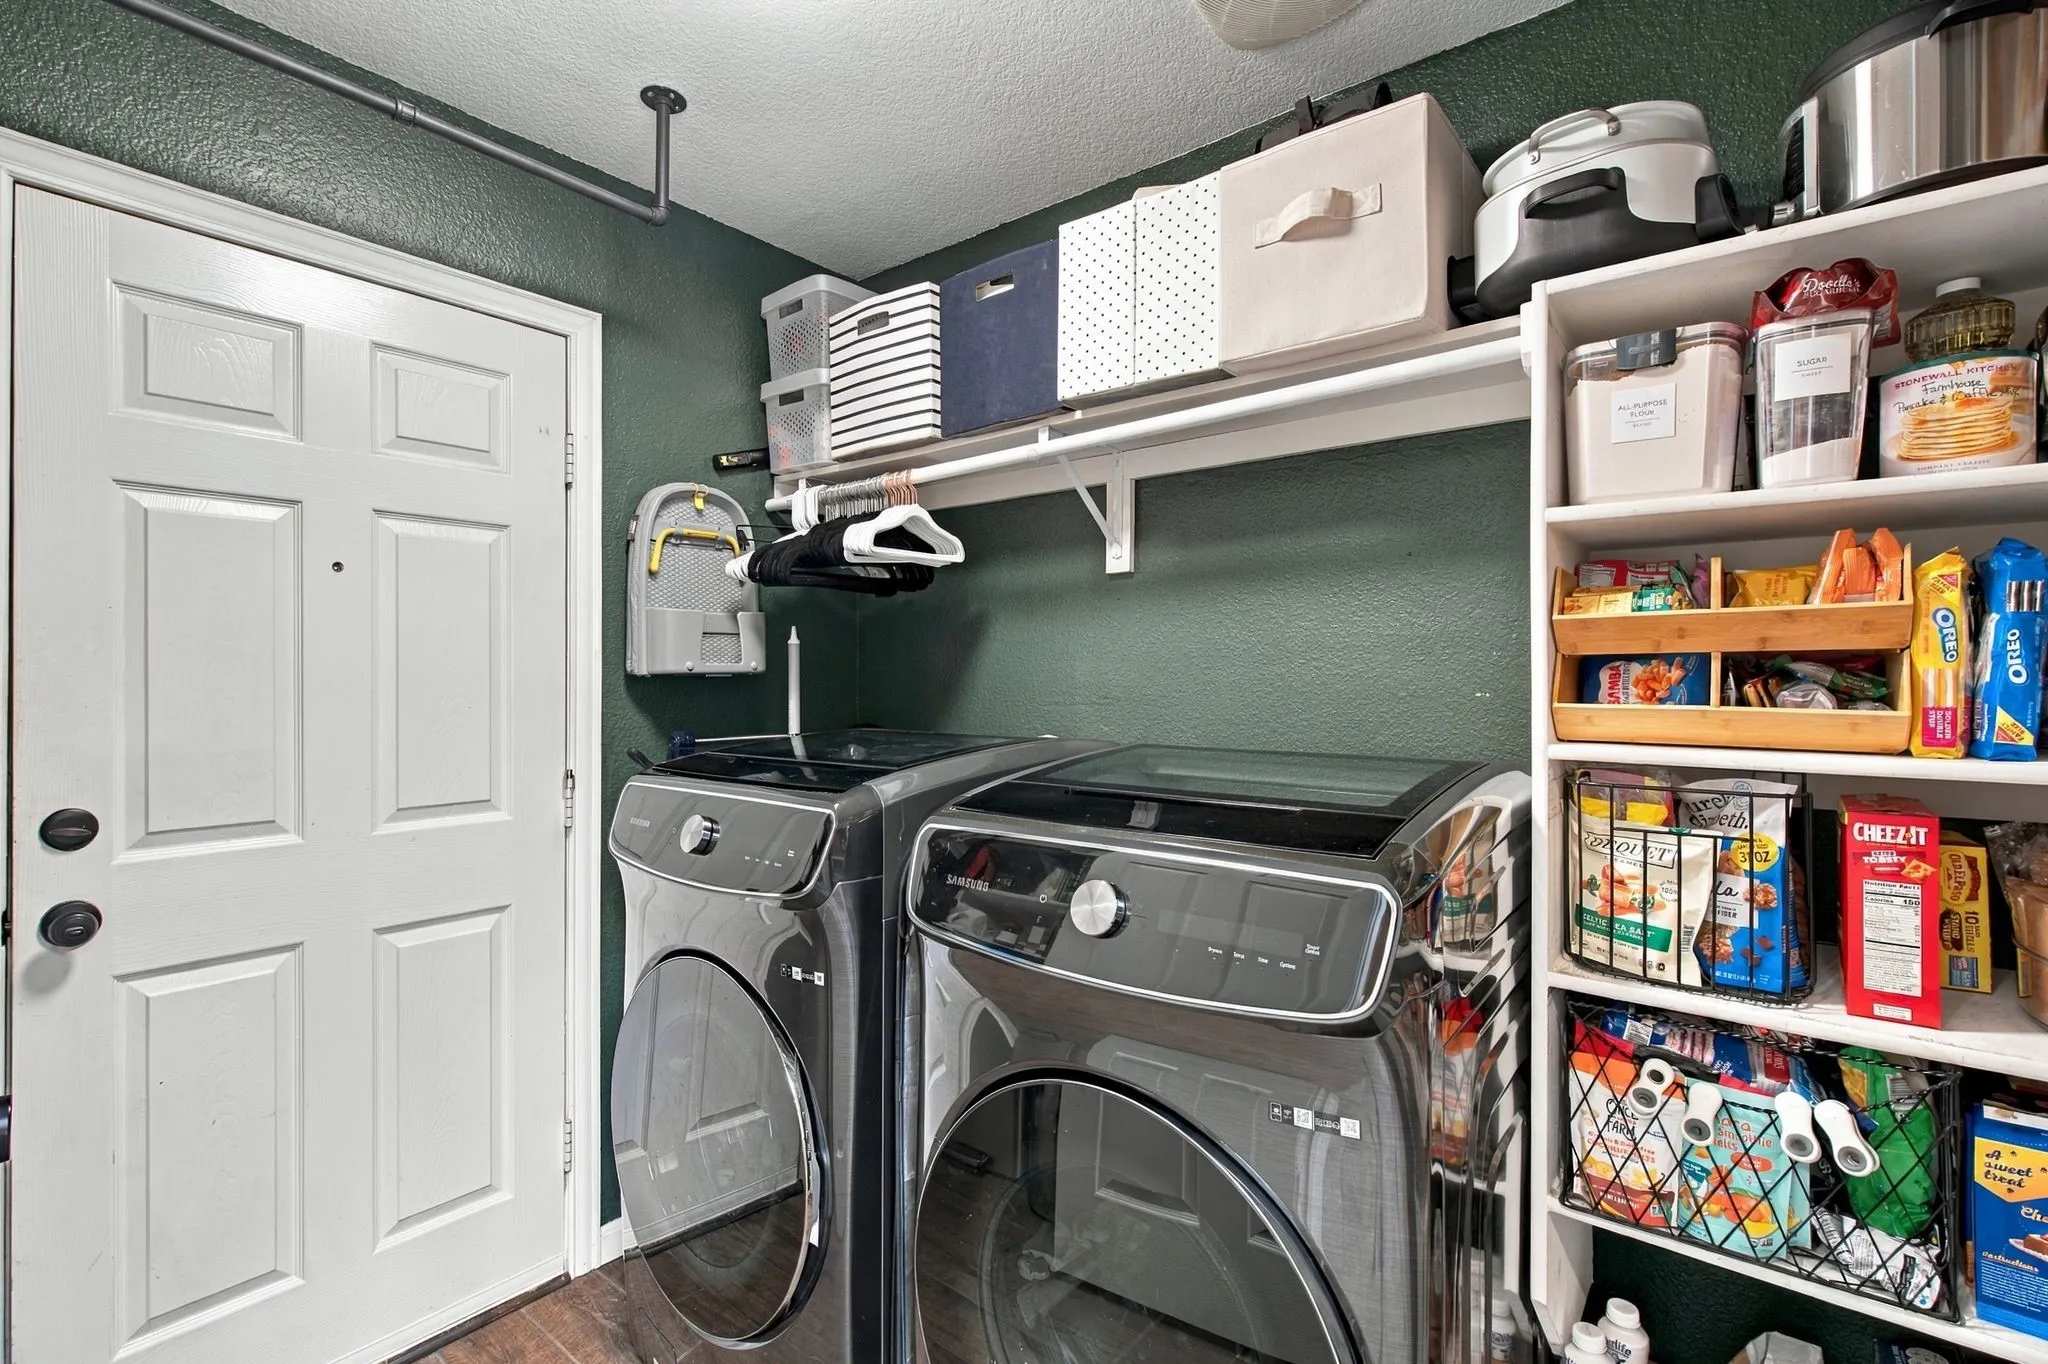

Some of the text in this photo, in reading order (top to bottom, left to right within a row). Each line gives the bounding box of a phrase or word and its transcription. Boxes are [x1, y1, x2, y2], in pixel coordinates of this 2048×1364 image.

[1797, 356, 1828, 367] SUGAR
[1894, 371, 1962, 389] STONEWALL
[1921, 380, 1985, 395] Farmhouse
[1630, 410, 1655, 418] FLOUR
[1934, 609, 1957, 662] OREO
[2007, 629, 2027, 684] OREO
[946, 873, 990, 892] SAMSUNG
[1965, 910, 1980, 925] 10
[1607, 1114, 1637, 1141] FARM
[1985, 1150, 2002, 1161] A
[1984, 1161, 2033, 1178] sweet
[1984, 1170, 2026, 1189] treat
